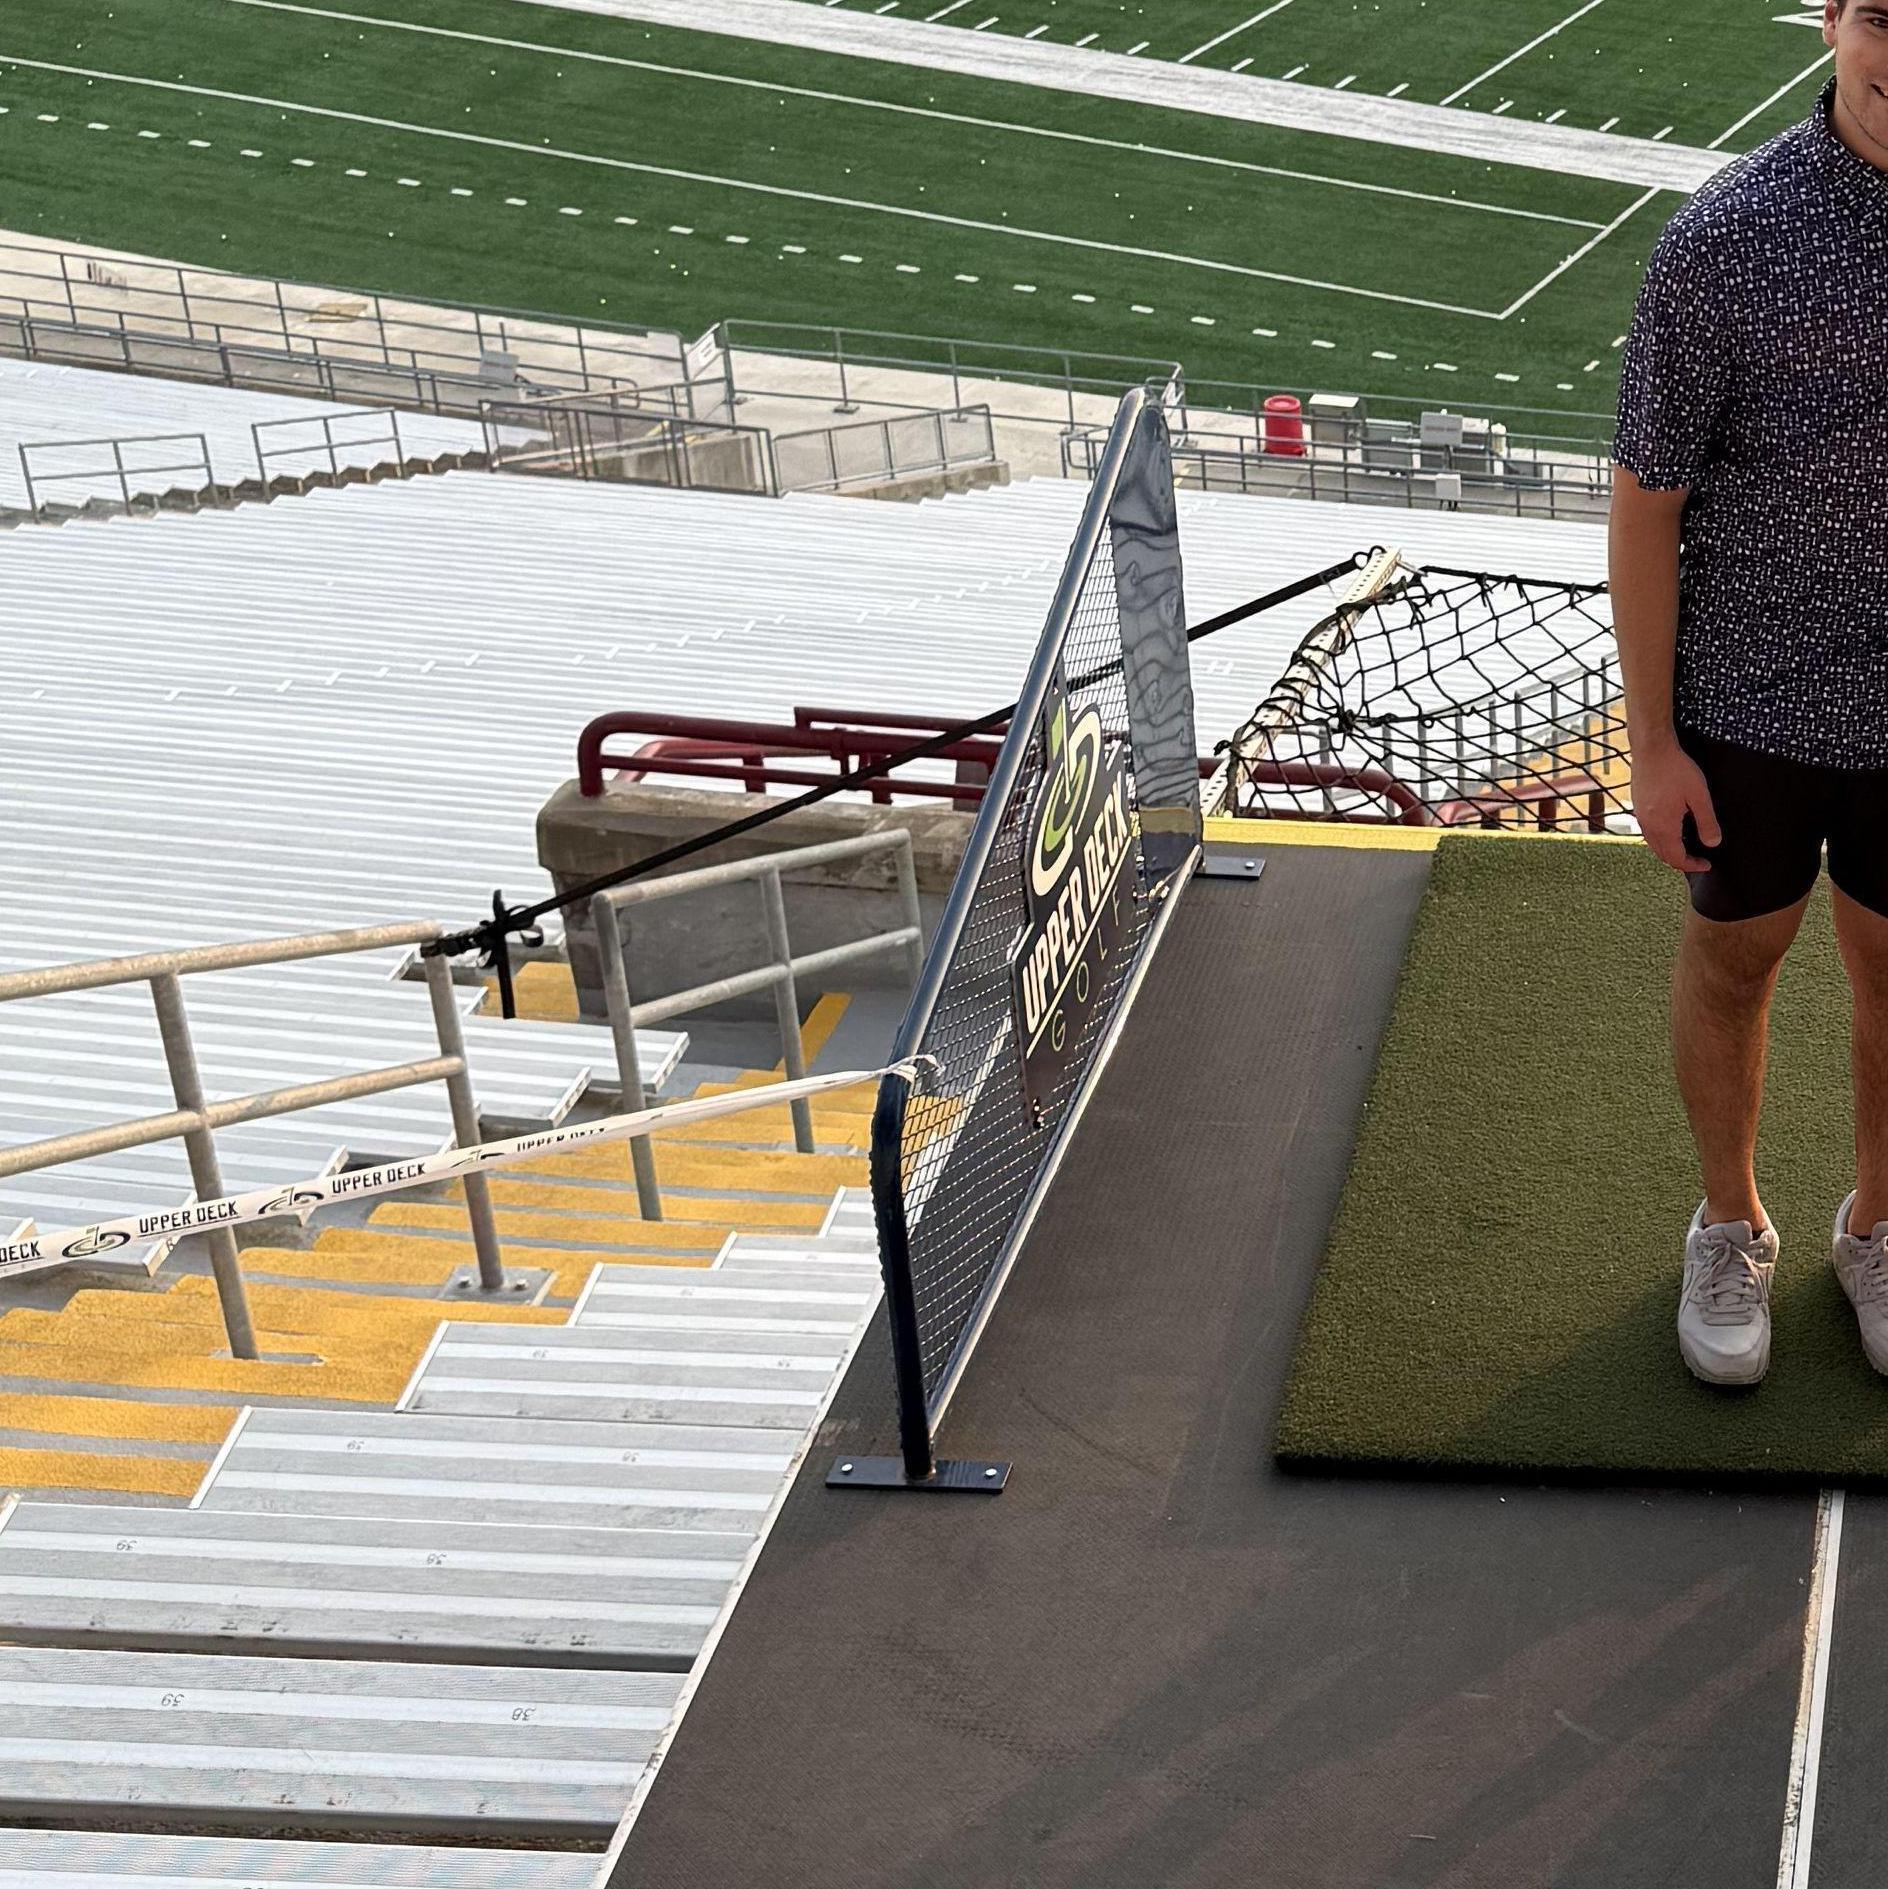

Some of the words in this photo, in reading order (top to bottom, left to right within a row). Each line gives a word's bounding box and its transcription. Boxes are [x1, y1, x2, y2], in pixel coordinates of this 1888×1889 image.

[1022, 866, 1086, 1034] UPPER
[1084, 770, 1129, 913] DECK
[1051, 885, 1121, 1052] GOLF
[139, 1211, 192, 1234] UPPER
[197, 1200, 238, 1223] DECK
[332, 1172, 382, 1194] UPPER
[387, 1163, 426, 1183] DECK
